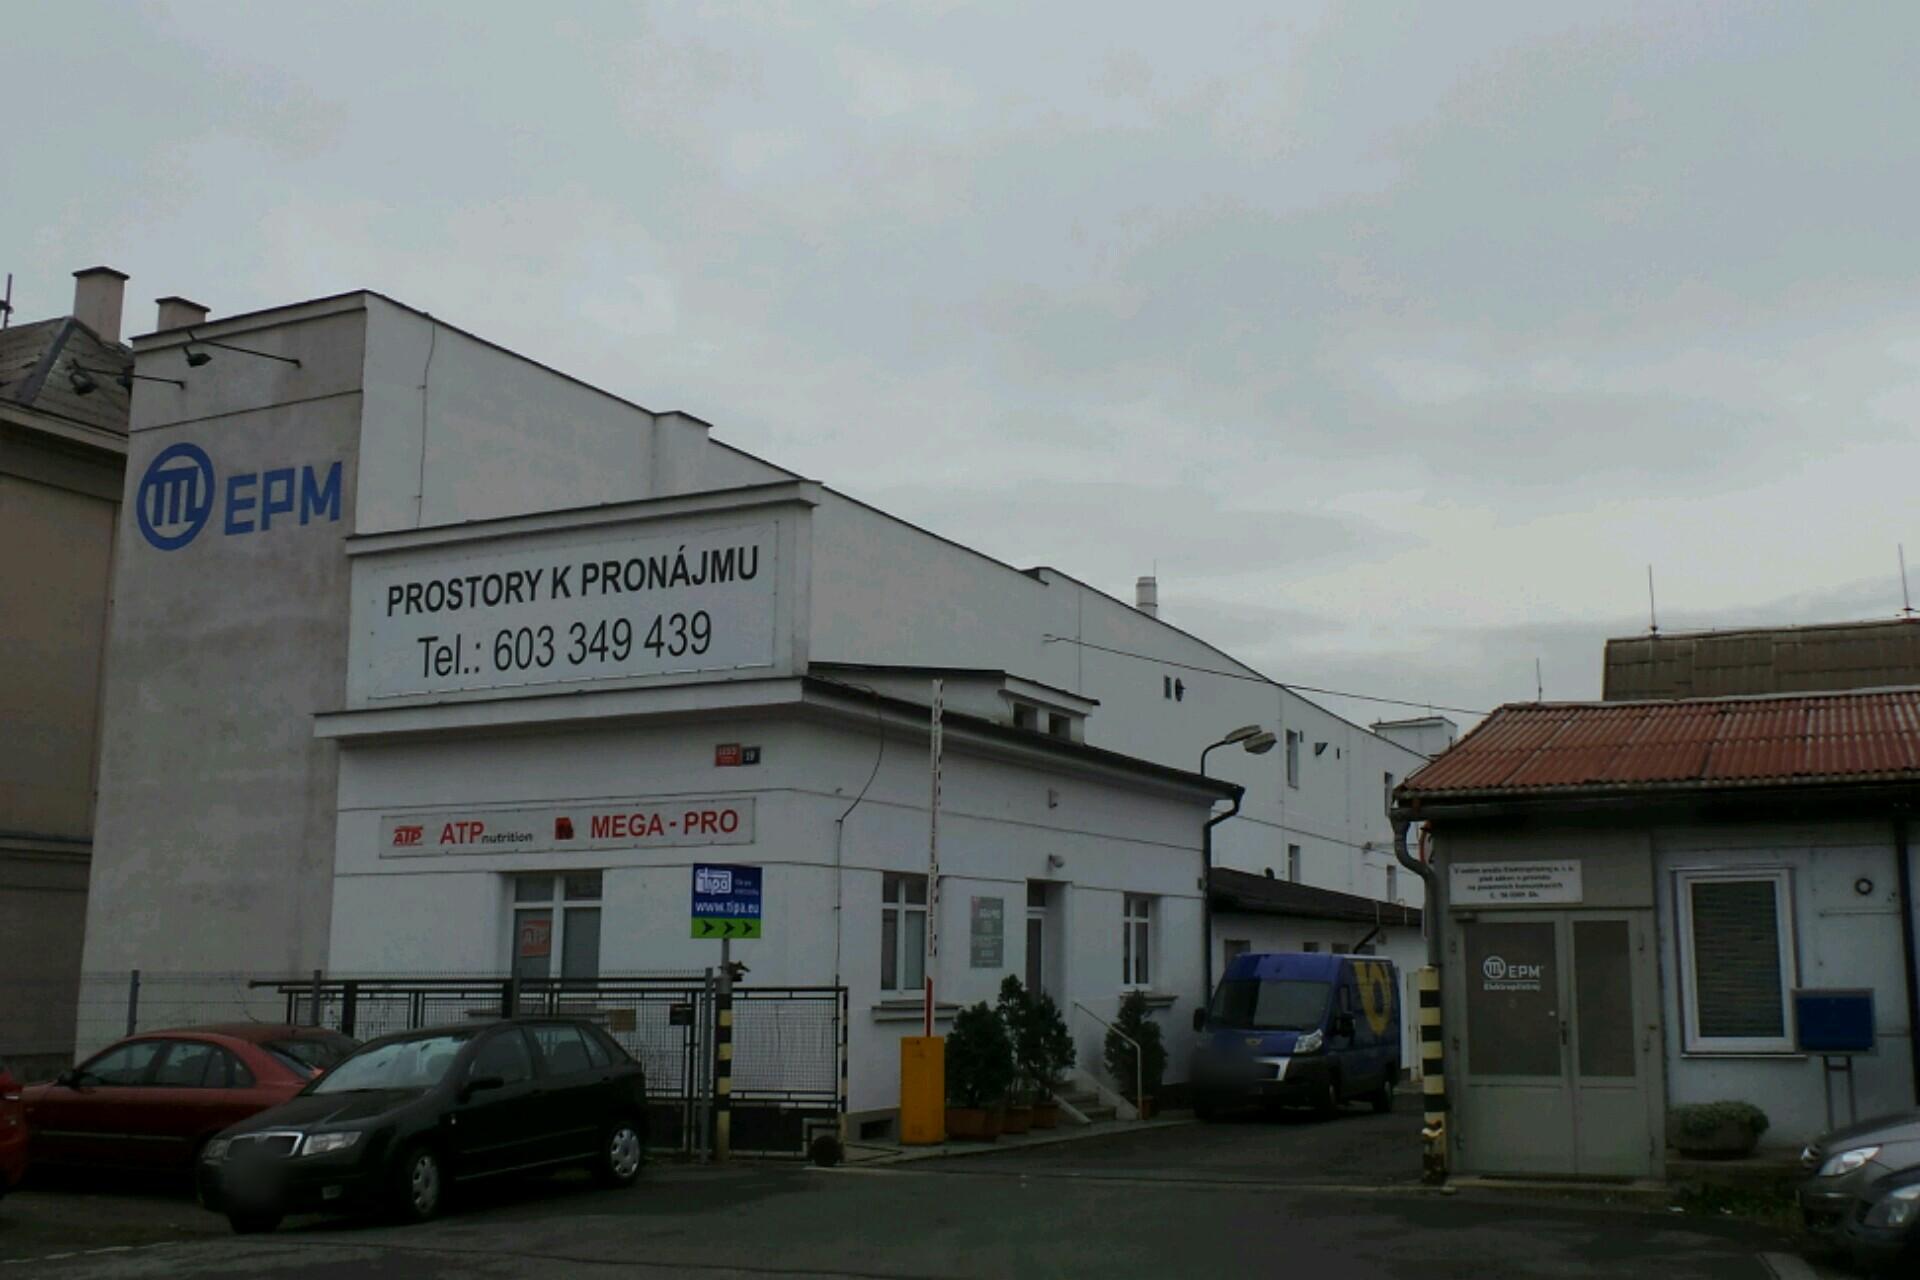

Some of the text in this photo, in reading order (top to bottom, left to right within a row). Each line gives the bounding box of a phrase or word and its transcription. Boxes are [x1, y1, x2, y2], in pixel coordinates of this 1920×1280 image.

[224, 462, 342, 535] EPM
[387, 545, 759, 617] PROSTORY K PRONÁJMU
[417, 610, 712, 679] Tel.: 603 349 439
[393, 826, 423, 846] ATP
[440, 821, 485, 845] ATP
[482, 831, 533, 844] nutrition
[591, 813, 664, 839] MEGA
[683, 809, 739, 836] PRO
[1508, 964, 1540, 978] EPM
